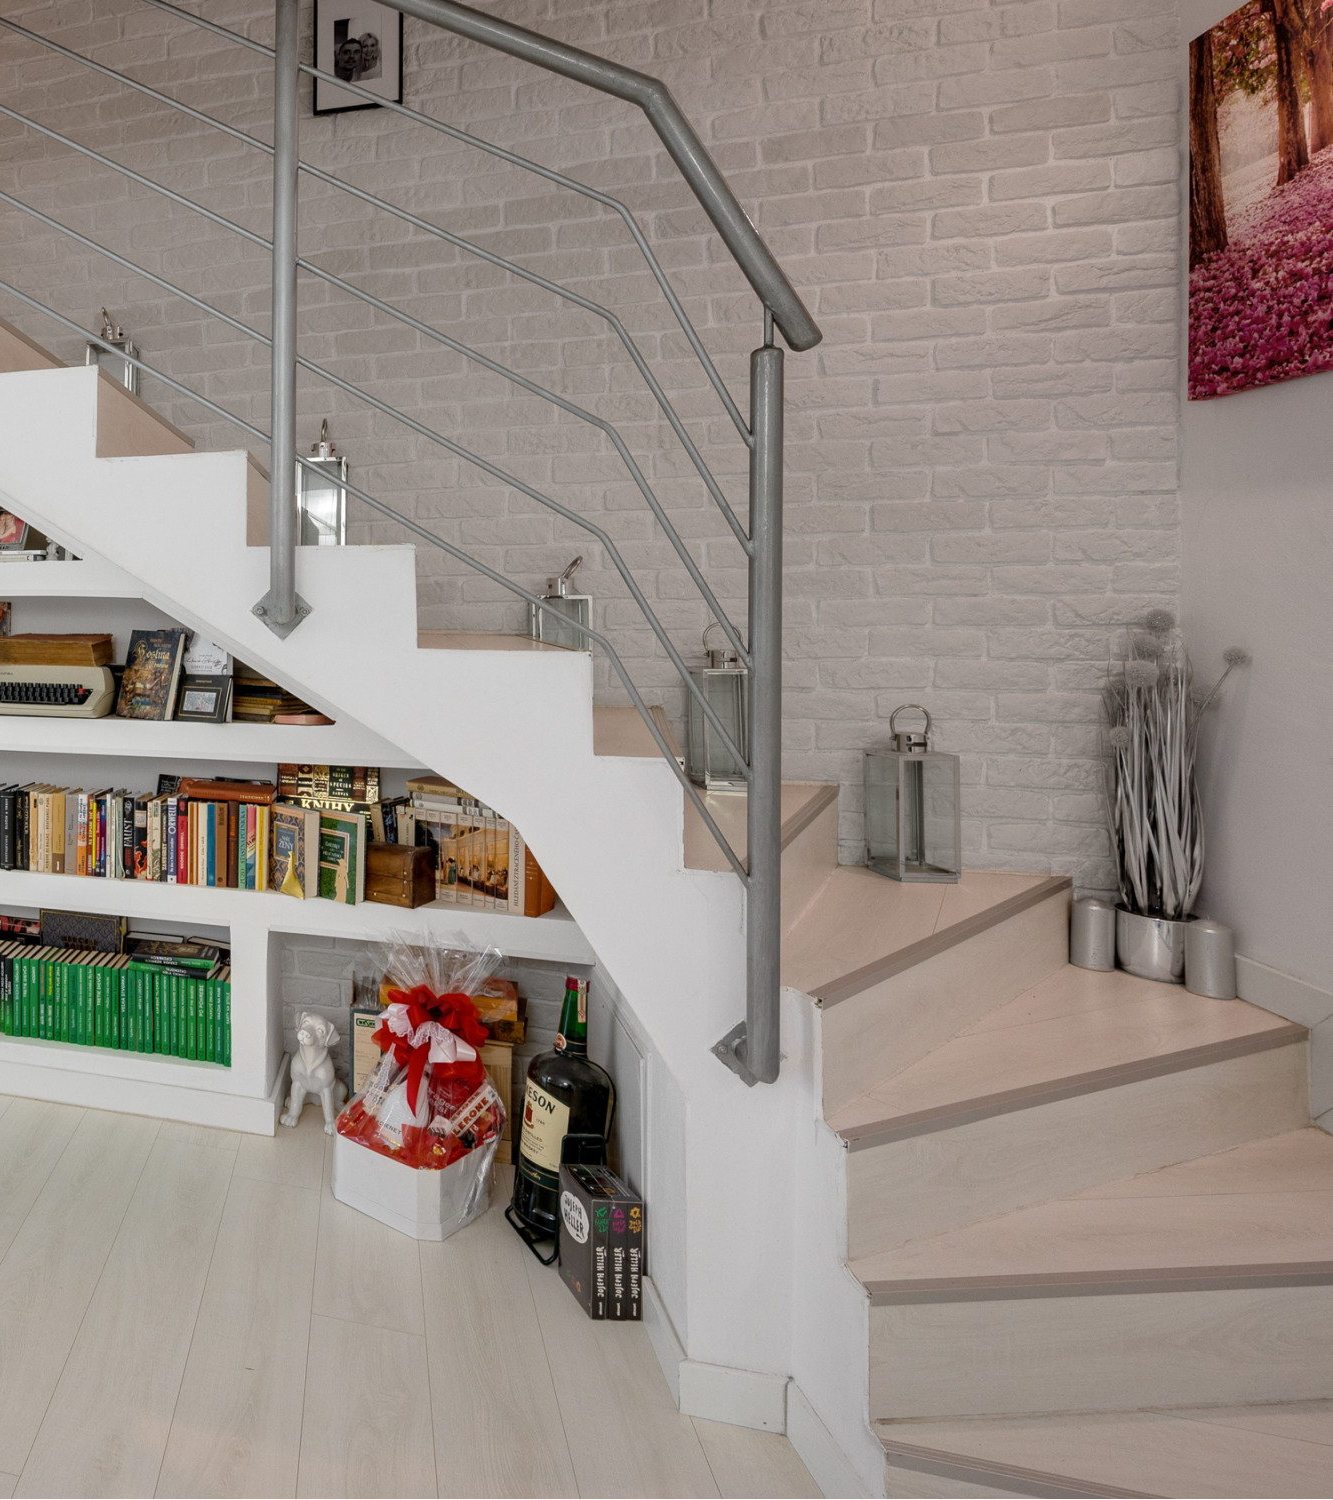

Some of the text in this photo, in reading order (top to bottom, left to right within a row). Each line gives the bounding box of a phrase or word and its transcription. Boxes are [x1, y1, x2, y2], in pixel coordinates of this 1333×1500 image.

[301, 798, 354, 812] KNIHY
[124, 818, 133, 848] FAUST
[168, 806, 176, 835] ORWELL
[278, 839, 294, 850] ŽENY
[527, 1085, 556, 1115] ESON
[565, 1194, 582, 1220] JOSEPH
[564, 1209, 585, 1239] HELLER
[596, 1246, 606, 1297] JOSEPH HELLER
[614, 1247, 624, 1298] JOSEPH HELLER
[630, 1248, 640, 1299] JOSEPH HELLER
